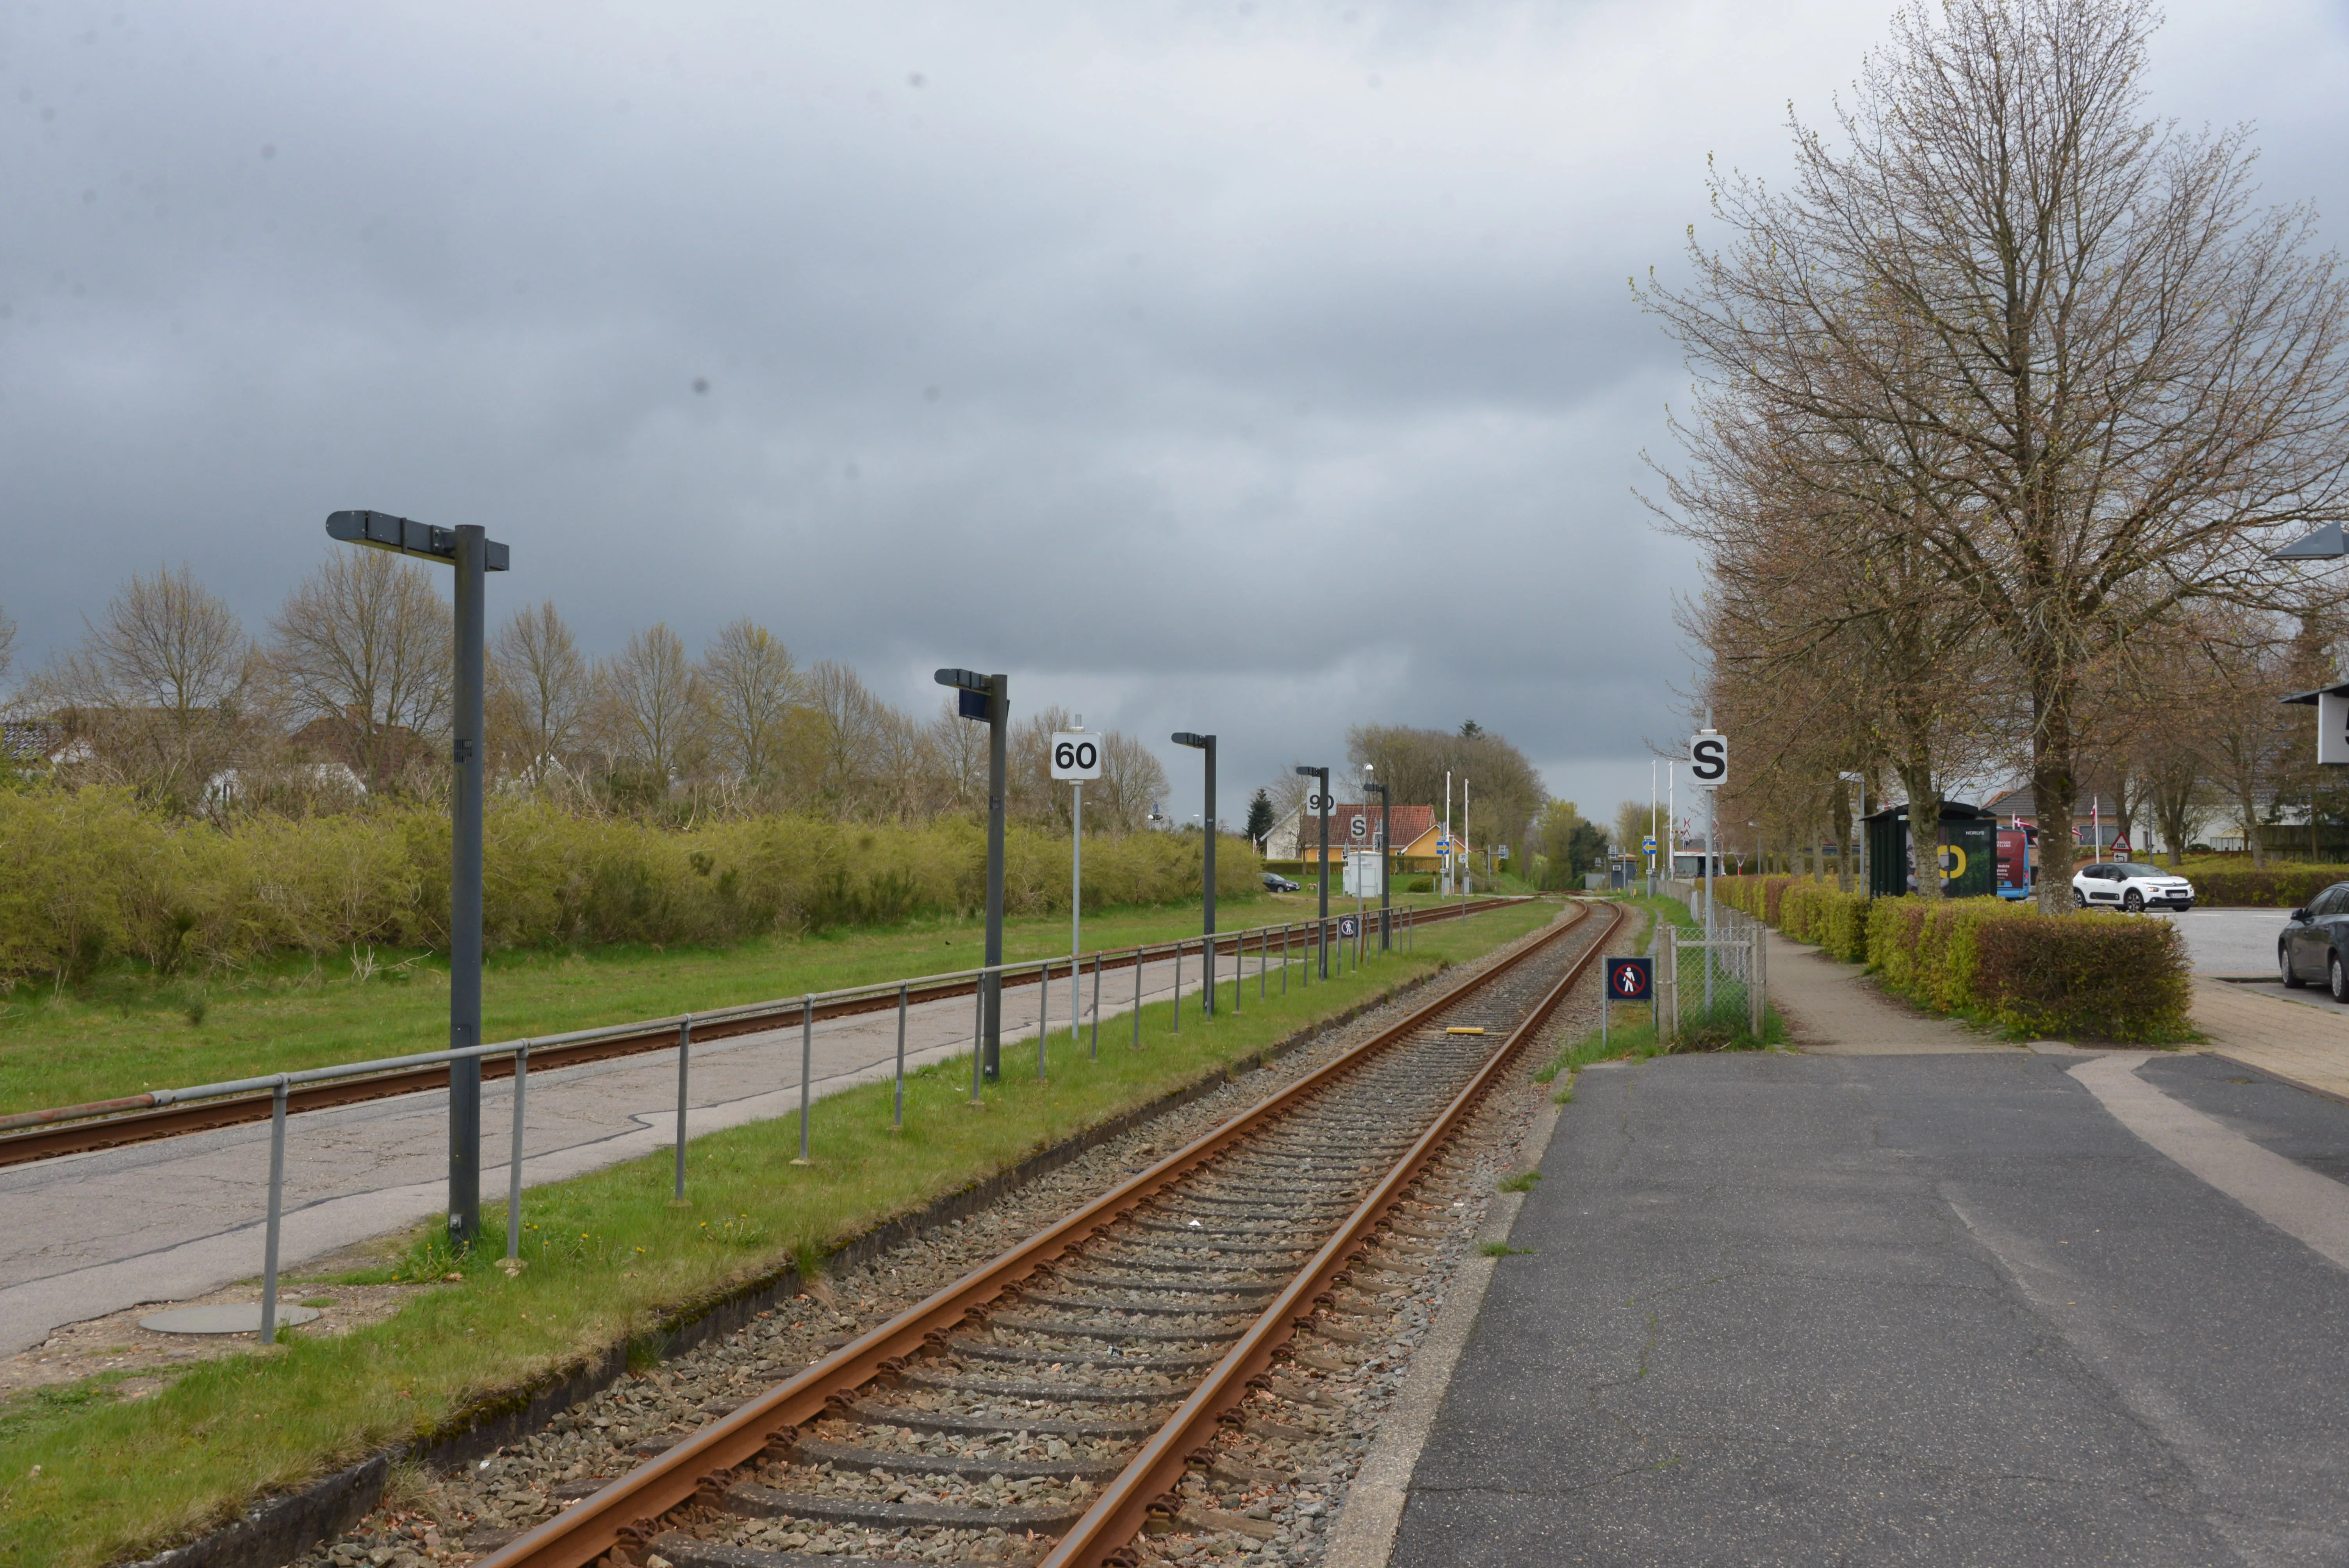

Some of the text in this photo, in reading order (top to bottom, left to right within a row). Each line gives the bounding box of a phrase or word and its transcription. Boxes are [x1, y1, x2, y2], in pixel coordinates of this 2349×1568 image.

[1055, 742, 1097, 769] 60
[1692, 740, 1725, 780] S
[1352, 820, 1365, 836] S
